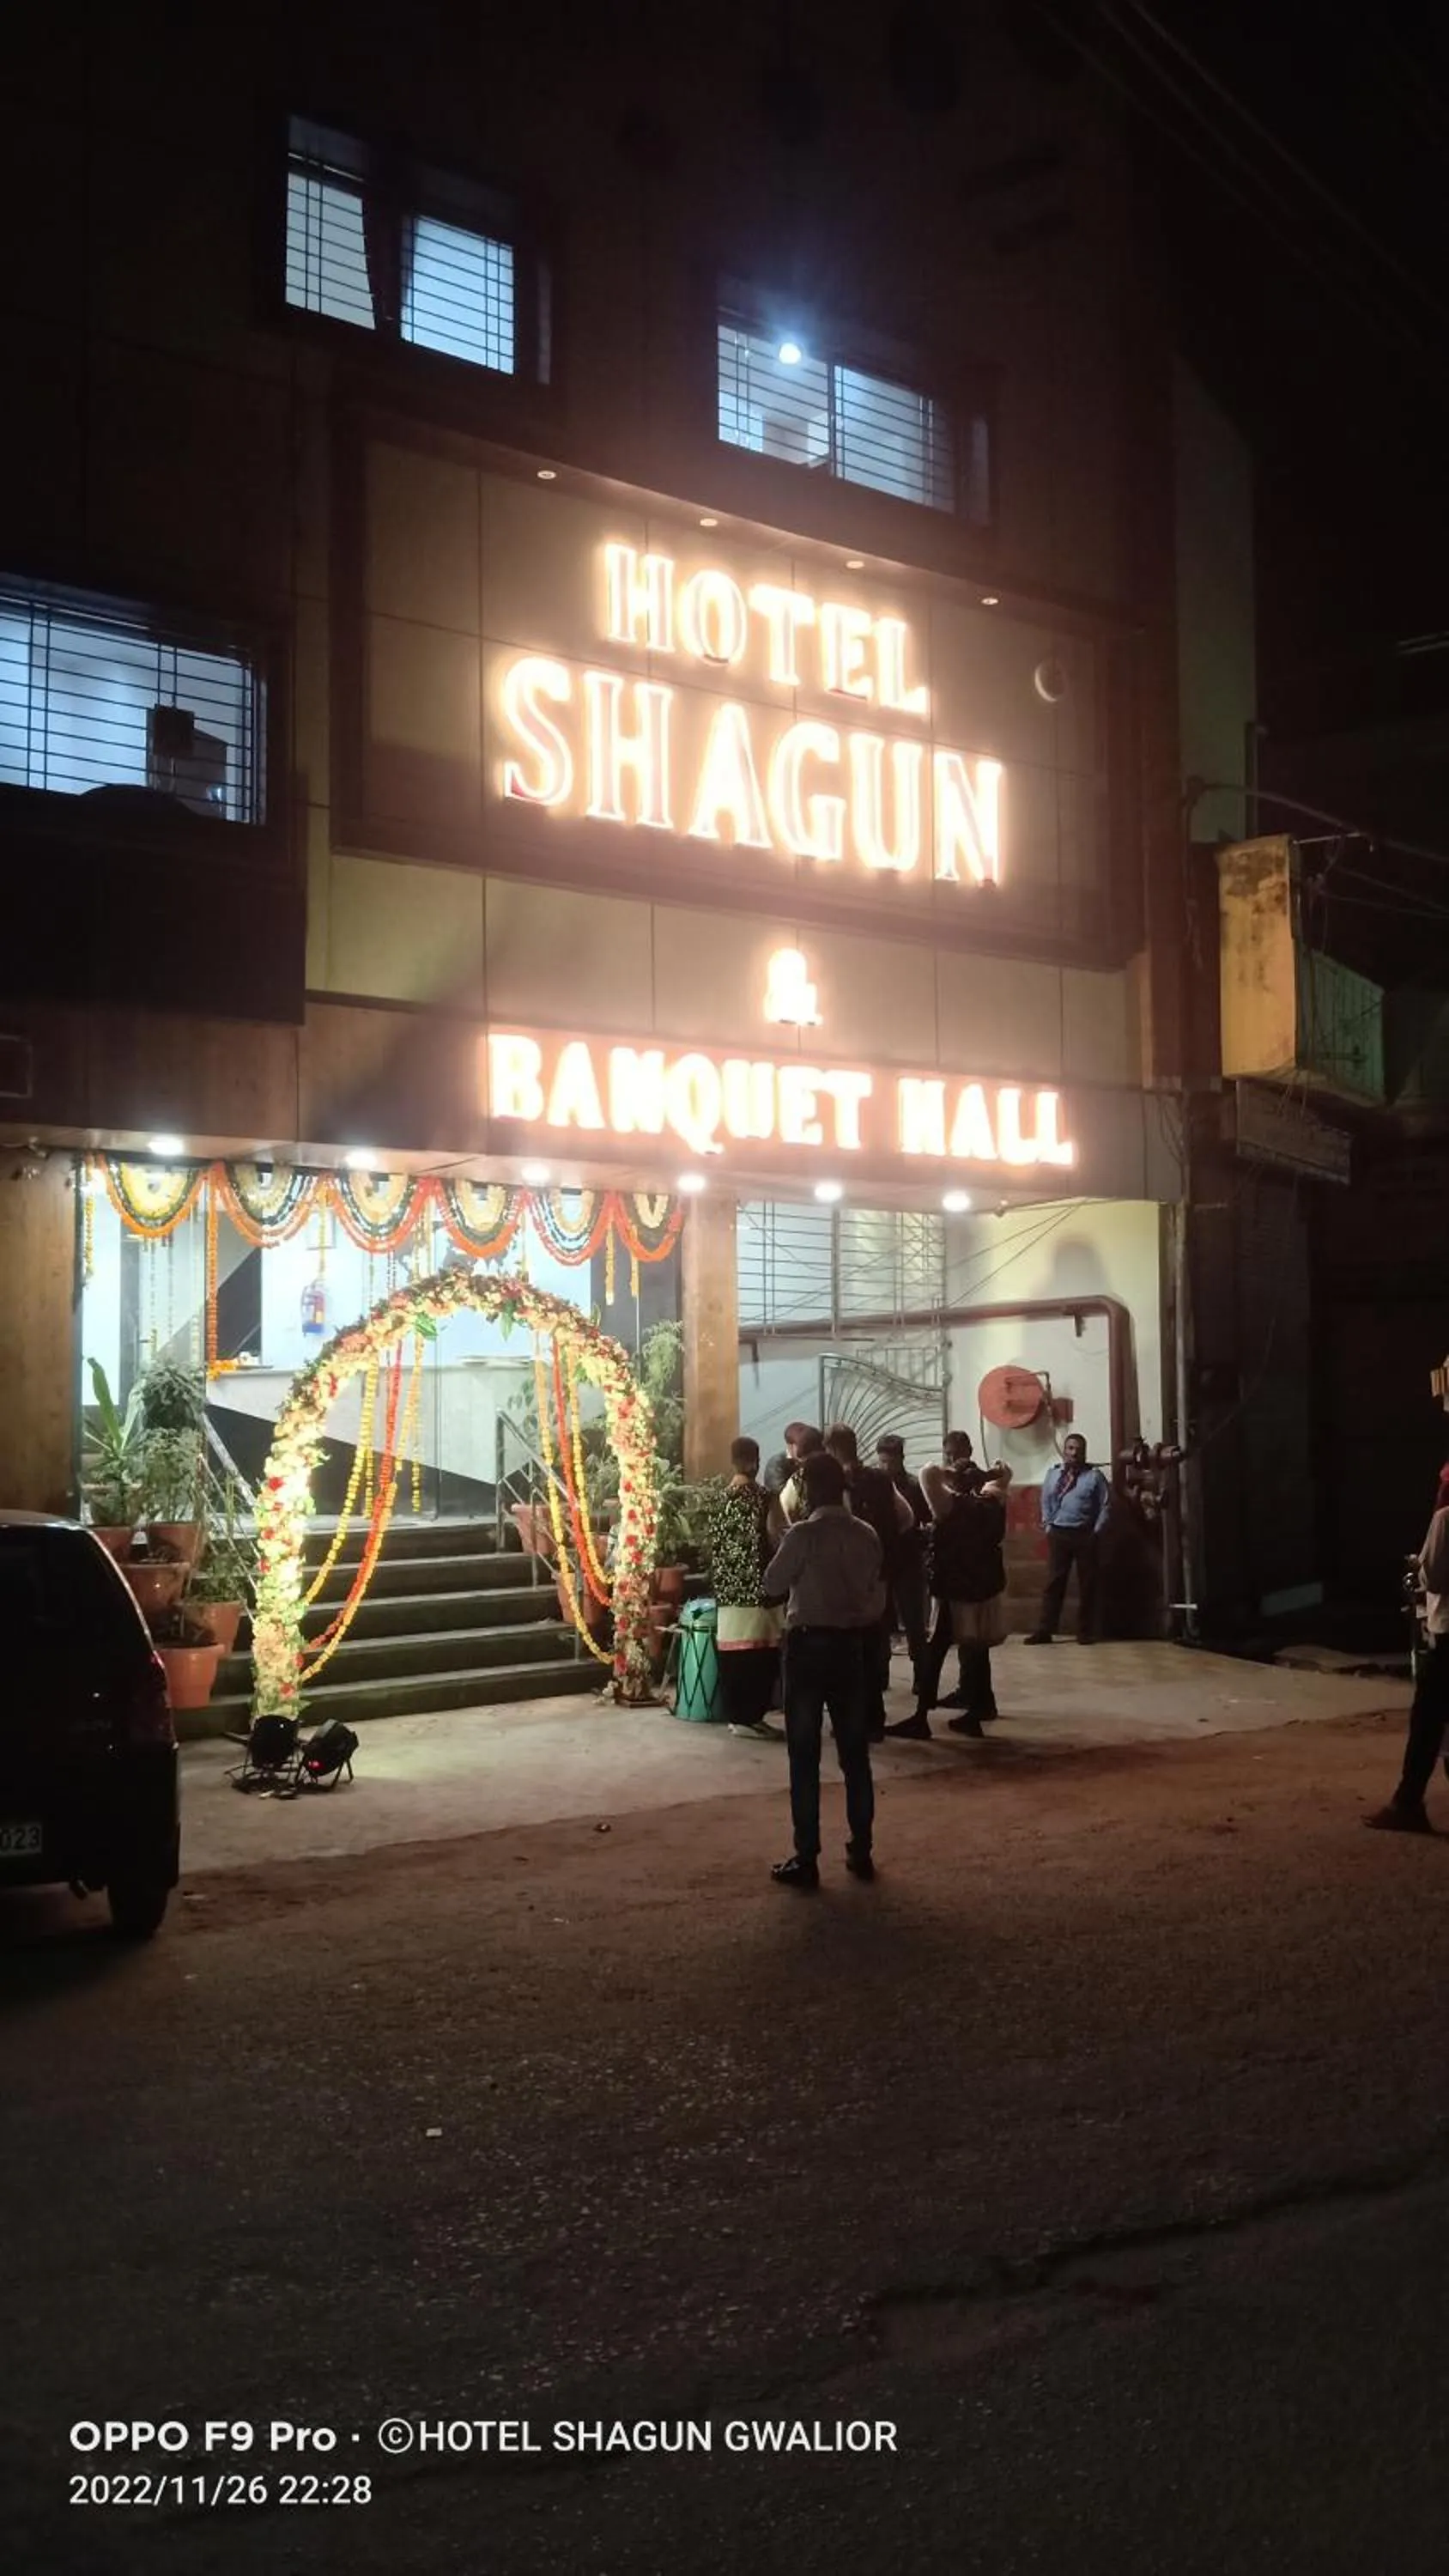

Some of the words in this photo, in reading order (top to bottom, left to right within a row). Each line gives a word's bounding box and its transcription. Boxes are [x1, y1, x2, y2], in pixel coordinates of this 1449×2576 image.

[603, 542, 930, 715] HOTEL
[501, 654, 1004, 888] SHAGUN
[763, 946, 824, 1026] &
[487, 1032, 873, 1156] BANQUET
[898, 1075, 1075, 1167] HALL
